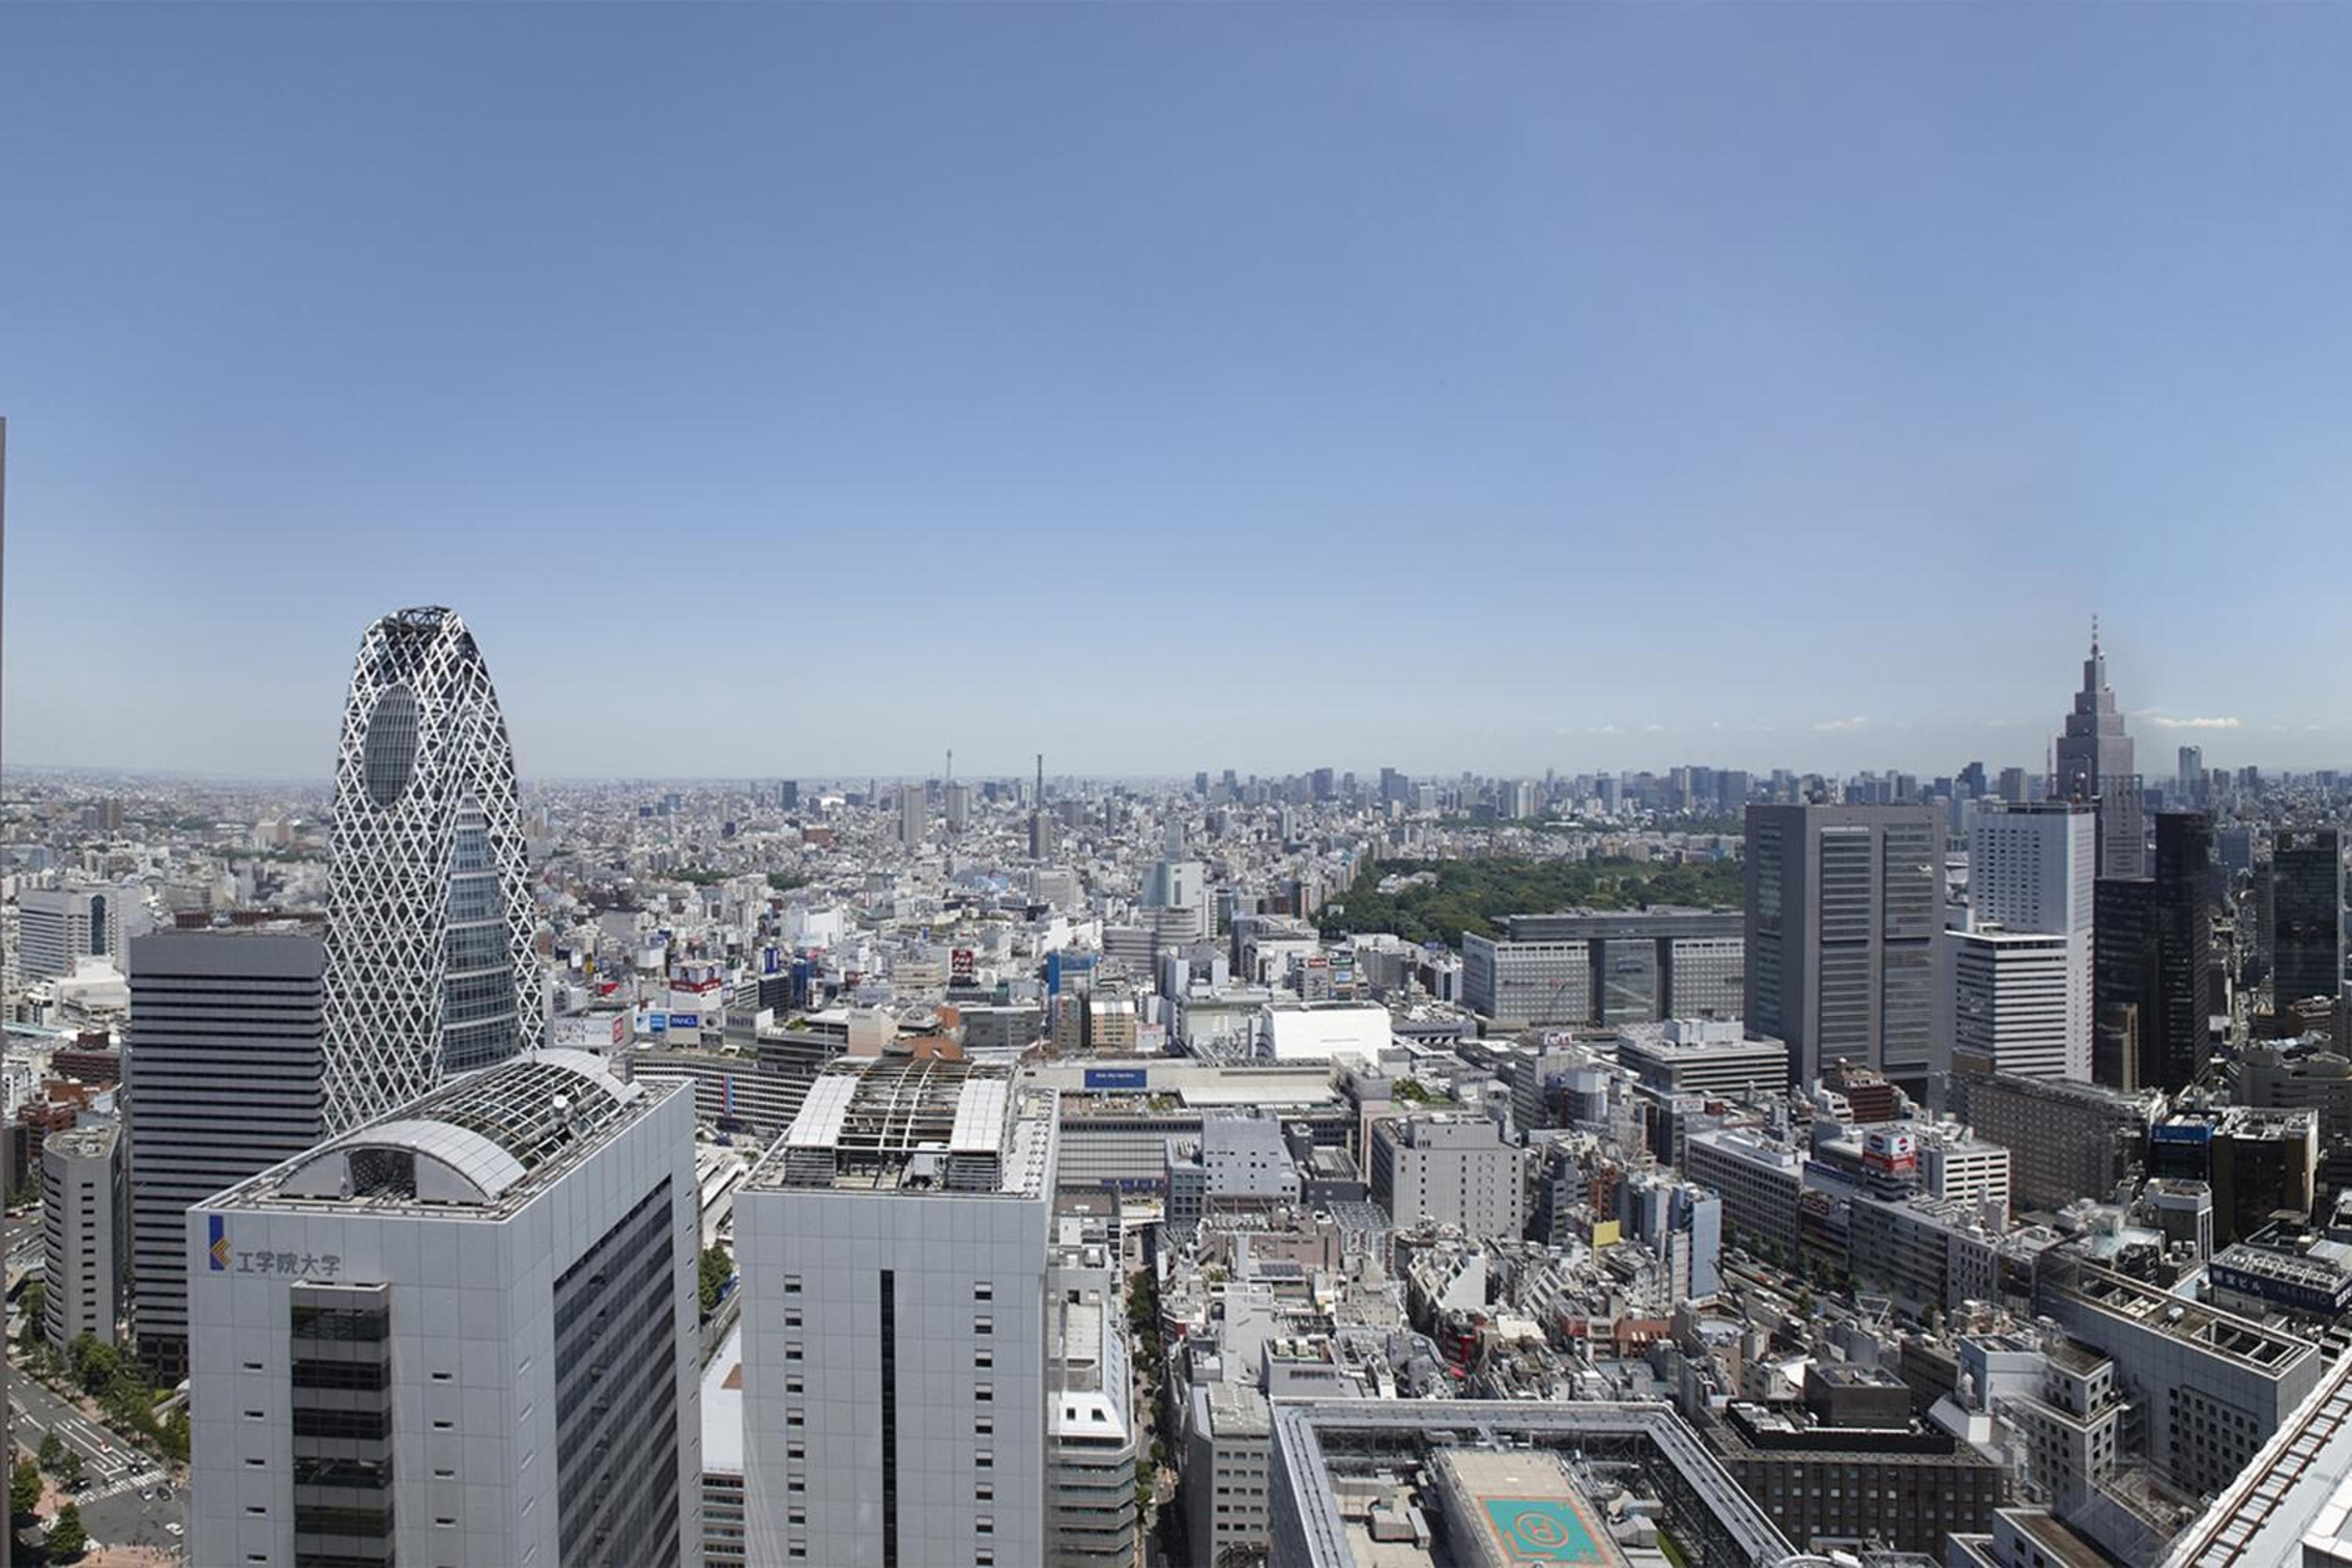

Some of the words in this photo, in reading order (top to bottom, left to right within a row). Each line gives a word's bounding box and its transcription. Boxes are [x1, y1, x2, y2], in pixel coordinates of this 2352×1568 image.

[237, 1251, 341, 1276] 工学院大学
